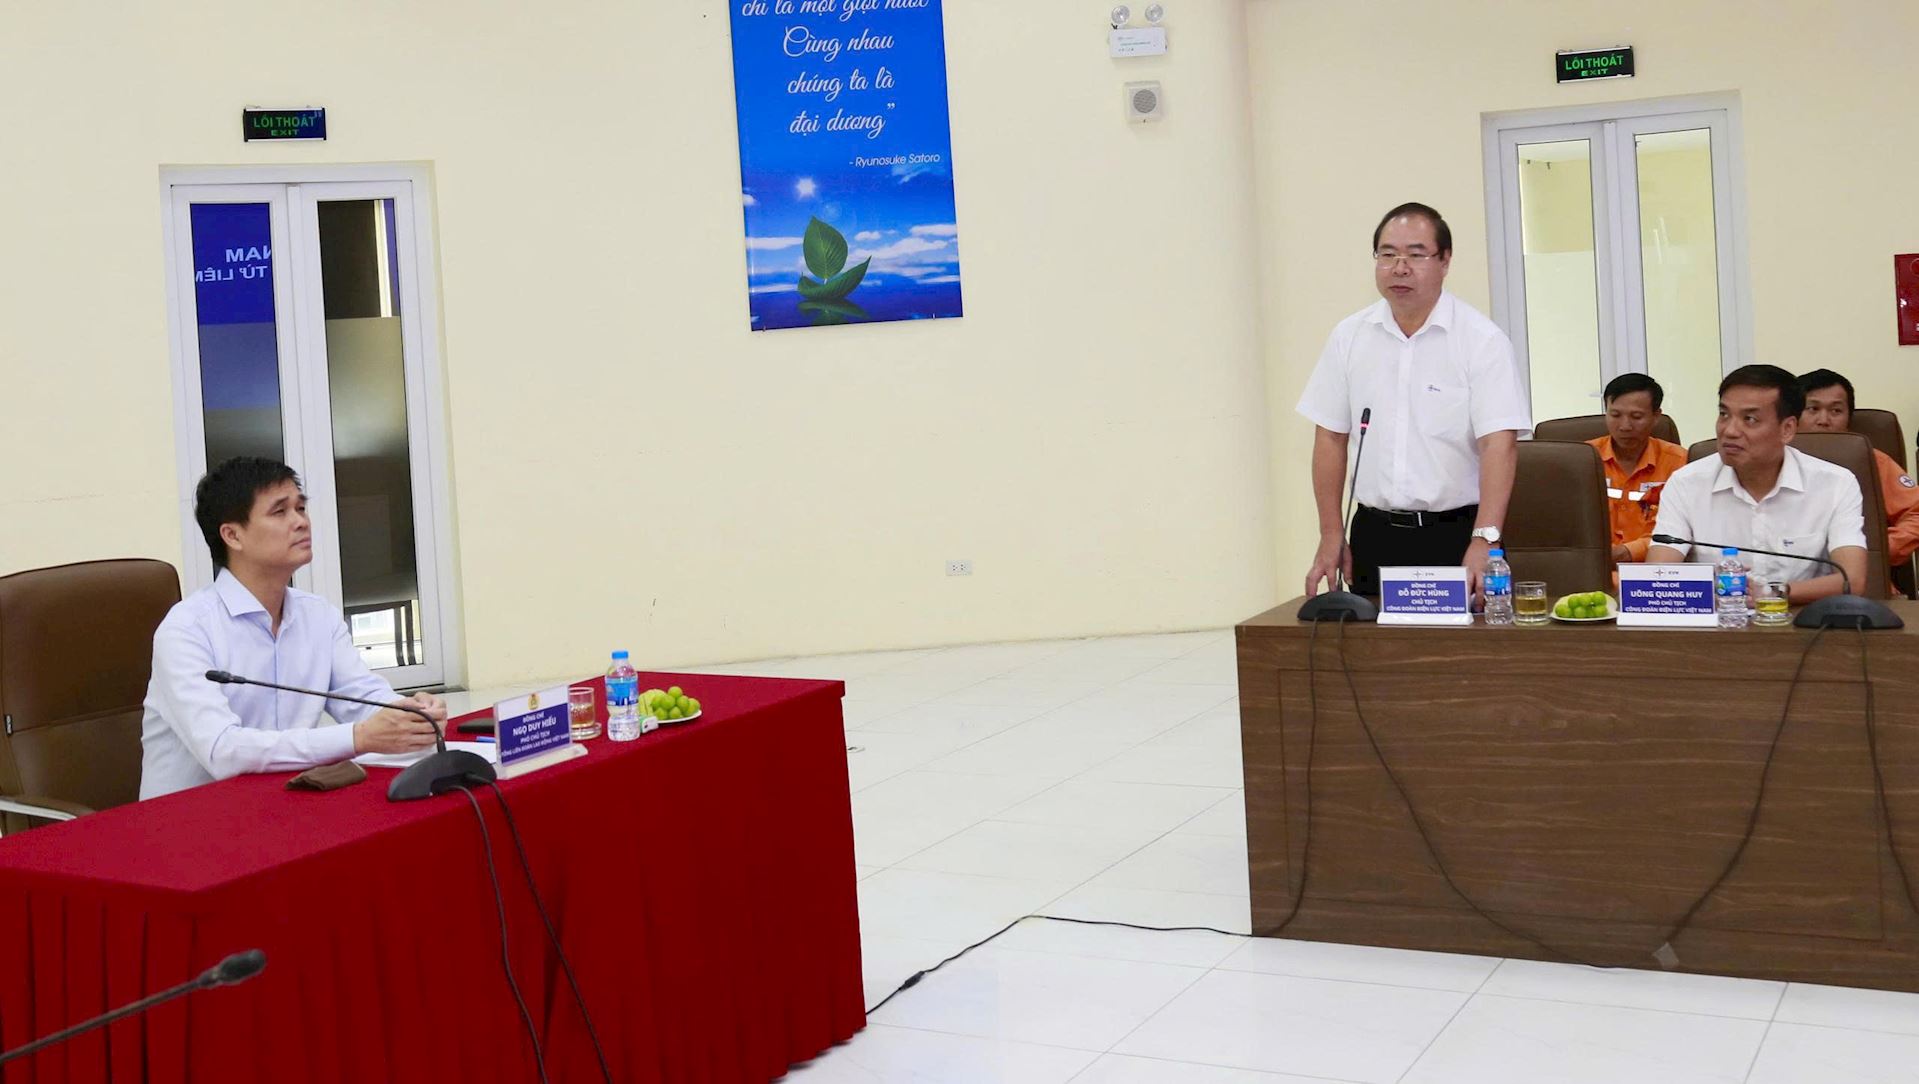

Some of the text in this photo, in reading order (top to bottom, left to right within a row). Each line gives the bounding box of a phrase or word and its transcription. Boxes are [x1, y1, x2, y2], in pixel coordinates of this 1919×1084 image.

[783, 26, 894, 62] Cùng nhau
[1585, 54, 1623, 68] THOÁT
[788, 66, 895, 102] chúng ta là
[275, 114, 316, 127] THOÁT
[790, 110, 820, 136] đại
[856, 155, 906, 169] Ryunosuke
[908, 153, 941, 164] Satoro
[1655, 591, 1685, 599] QUANG
[528, 721, 541, 732] DUY
